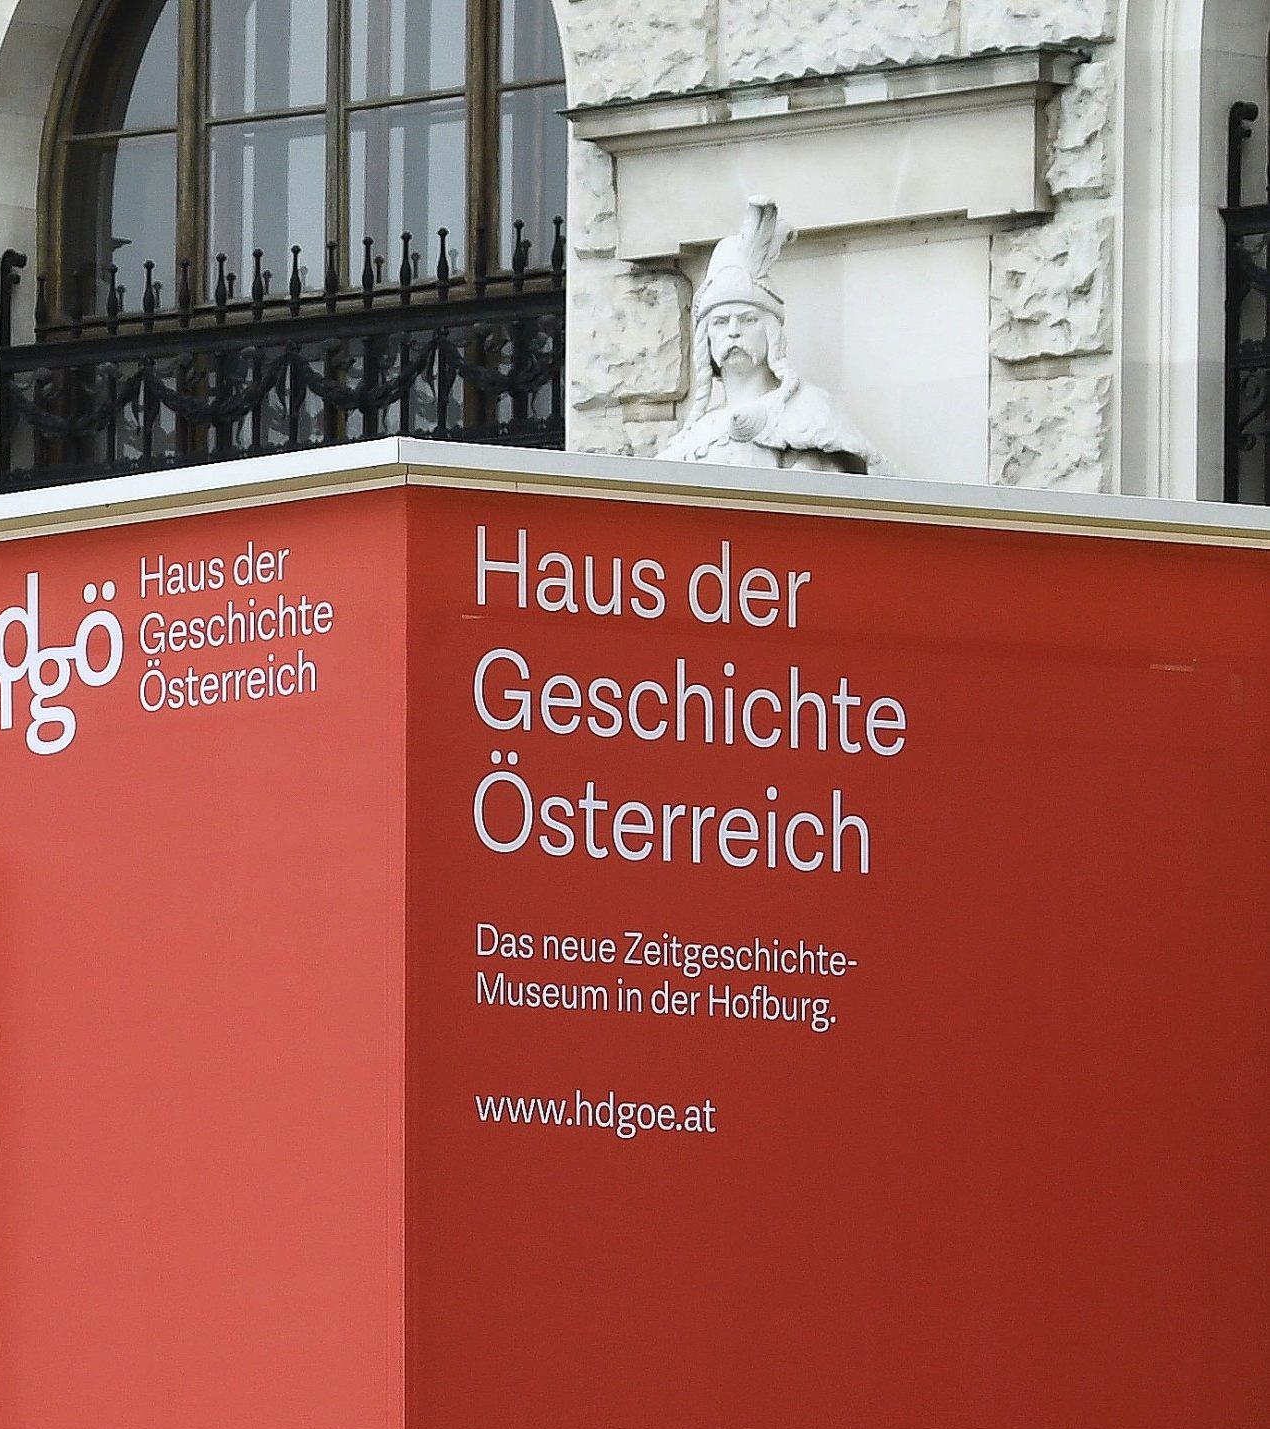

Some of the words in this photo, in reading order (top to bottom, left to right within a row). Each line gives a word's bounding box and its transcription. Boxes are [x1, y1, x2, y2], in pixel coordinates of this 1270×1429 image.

[140, 555, 224, 599] Haus
[233, 541, 290, 586] der
[477, 525, 666, 619] Haus
[688, 540, 811, 629] der
[139, 594, 333, 655] Geschichte
[139, 649, 316, 712] Österreich
[473, 648, 906, 756] Geschichte
[473, 750, 869, 874] Österreich
[477, 923, 534, 959] Das
[543, 935, 616, 963] neue
[623, 931, 858, 978] Zeitgeschichte-
[477, 971, 608, 1011] Museum
[616, 978, 642, 1013] in
[650, 980, 701, 1016] der
[709, 984, 838, 1033] Hofburg.
[475, 1089, 716, 1139] www.hdgoe.at
